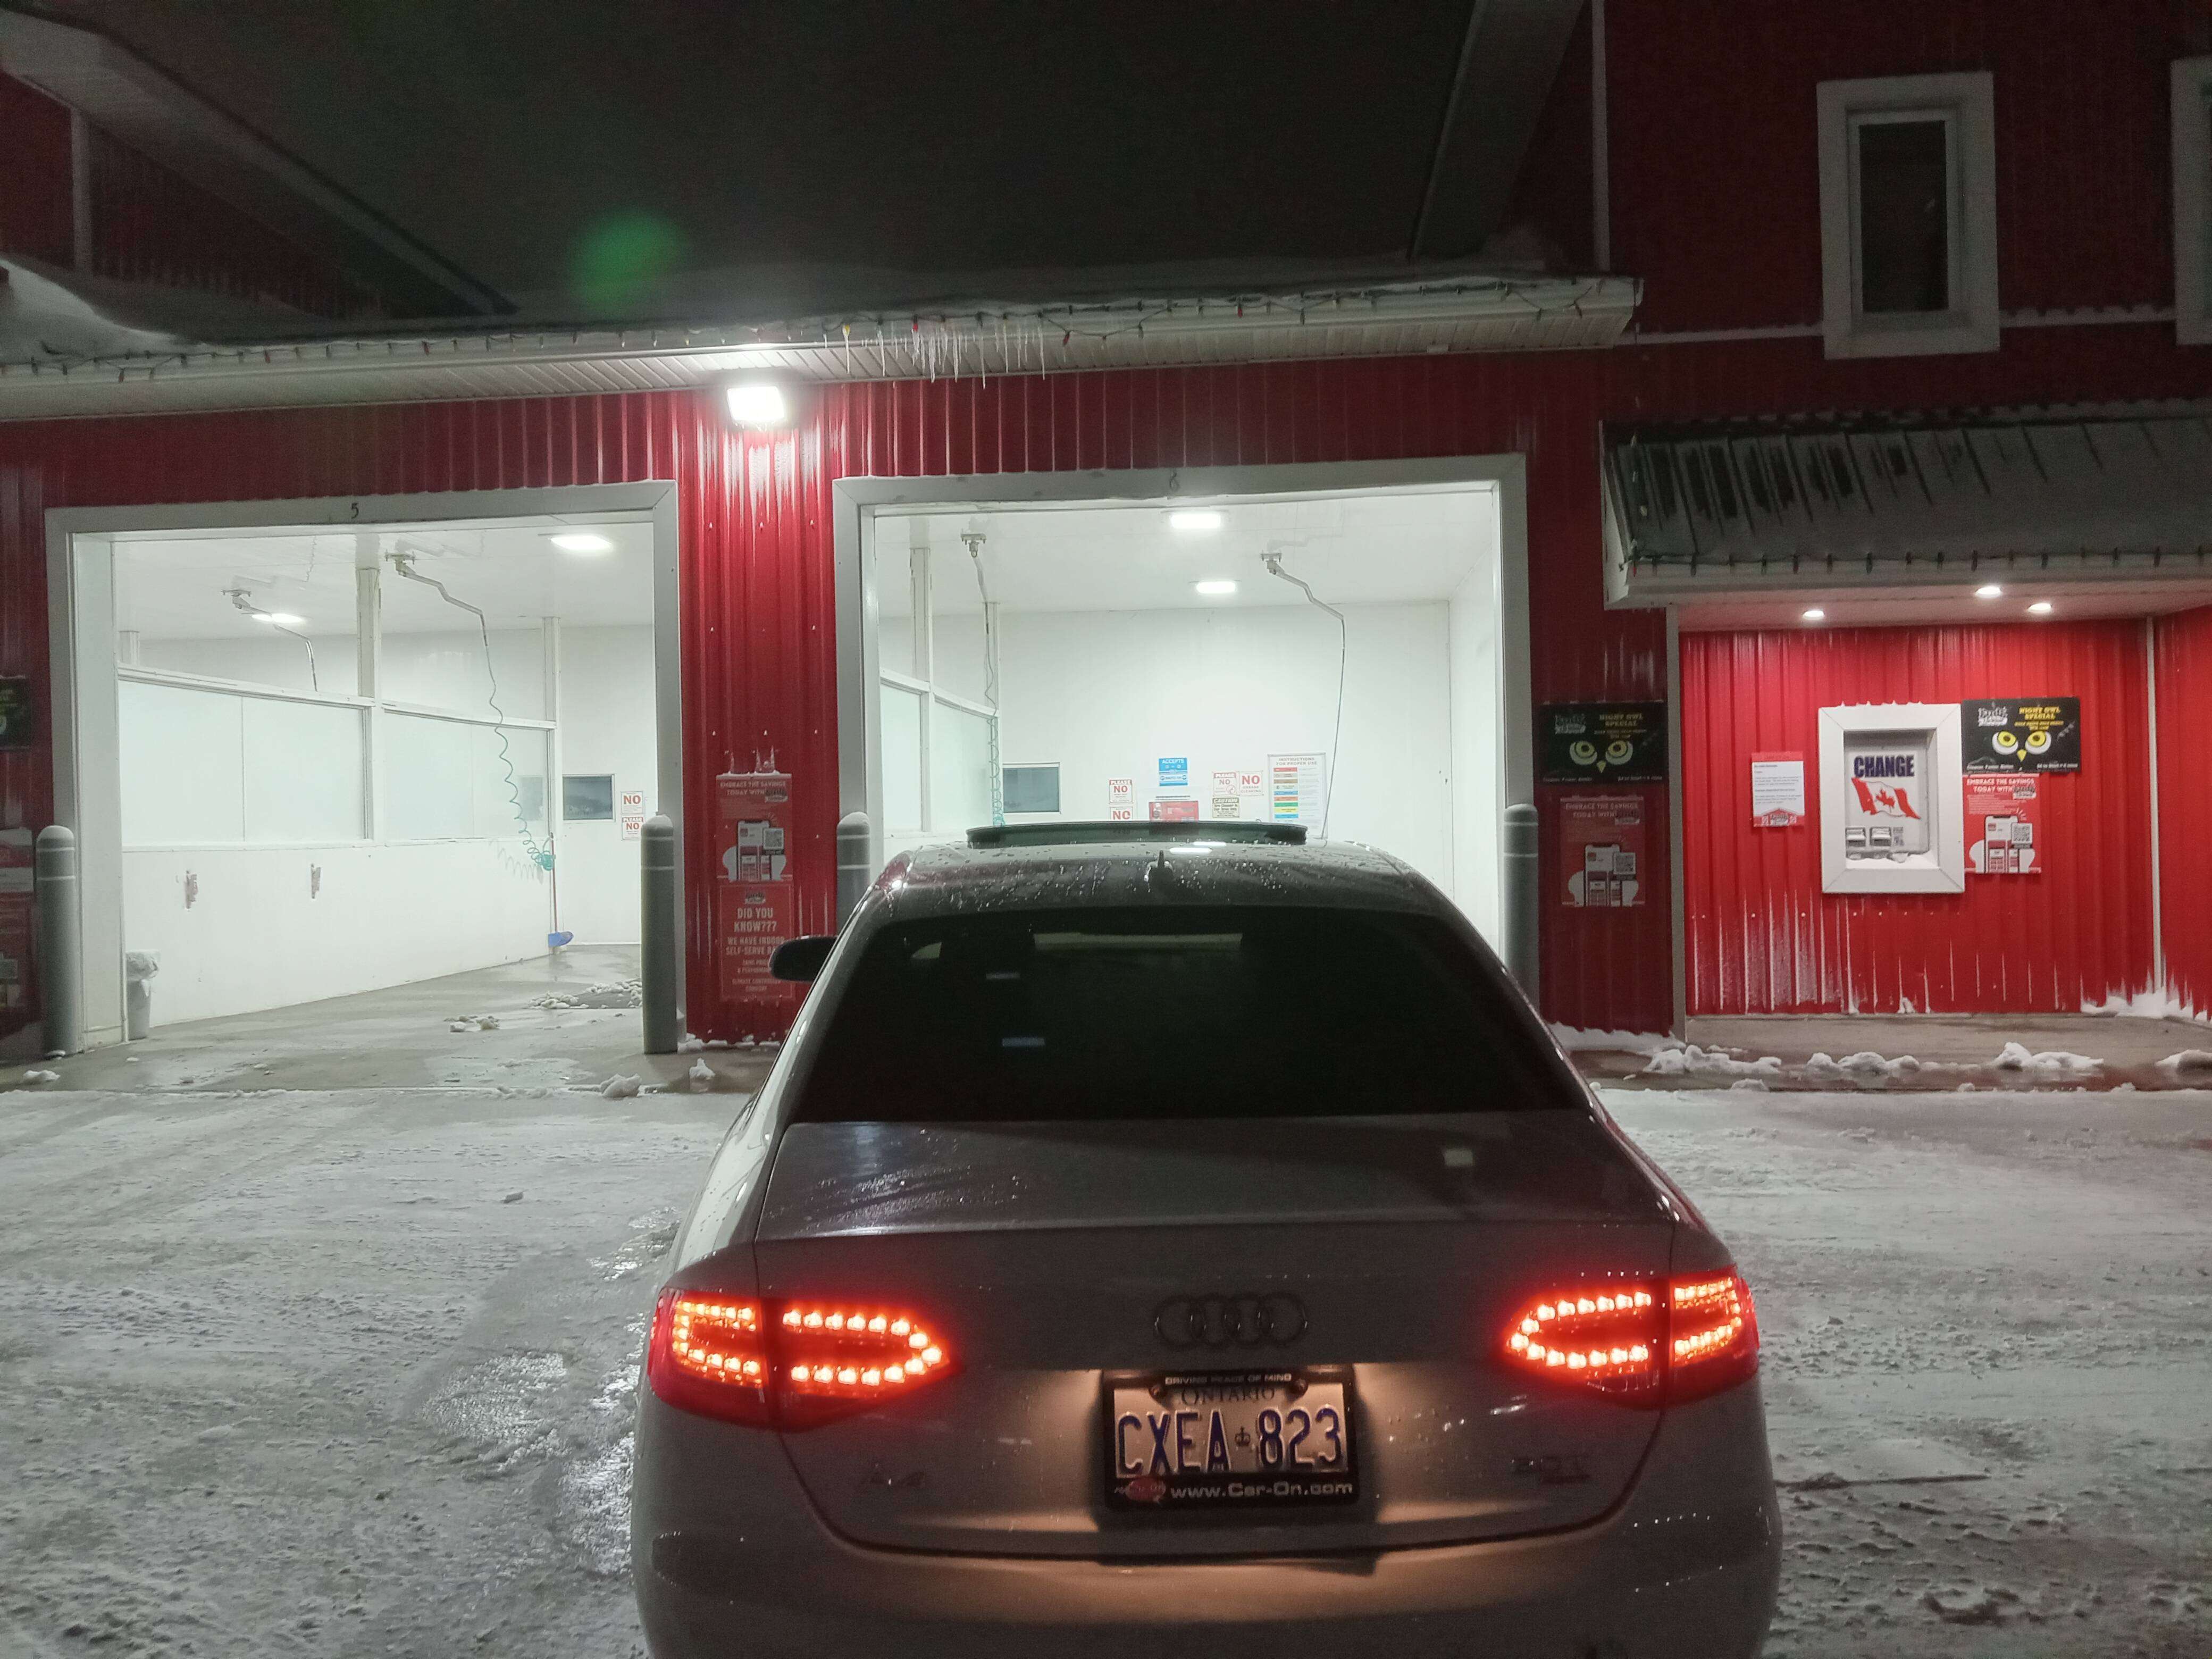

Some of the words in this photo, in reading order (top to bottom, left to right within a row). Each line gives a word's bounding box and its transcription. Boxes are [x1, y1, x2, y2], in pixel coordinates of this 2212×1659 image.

[351, 502, 359, 520] 5
[1854, 756, 1914, 777] CHANGE
[1242, 775, 1260, 784] NO
[624, 795, 641, 805] NO
[1112, 810, 1131, 820] NO
[738, 908, 752, 919] DID
[755, 907, 774, 919] YOU
[734, 920, 777, 932] KNOW???
[740, 936, 758, 945] HAVE
[726, 946, 766, 956] SELF-SERVE
[1165, 1376, 1207, 1385] DRIVING
[1264, 1373, 1292, 1382] MIND
[1182, 1386, 1275, 1405] ONTARIO
[1118, 1409, 1231, 1474] CXEA
[1258, 1406, 1342, 1471] 823
[1170, 1481, 1353, 1499] www.Car-On.com
